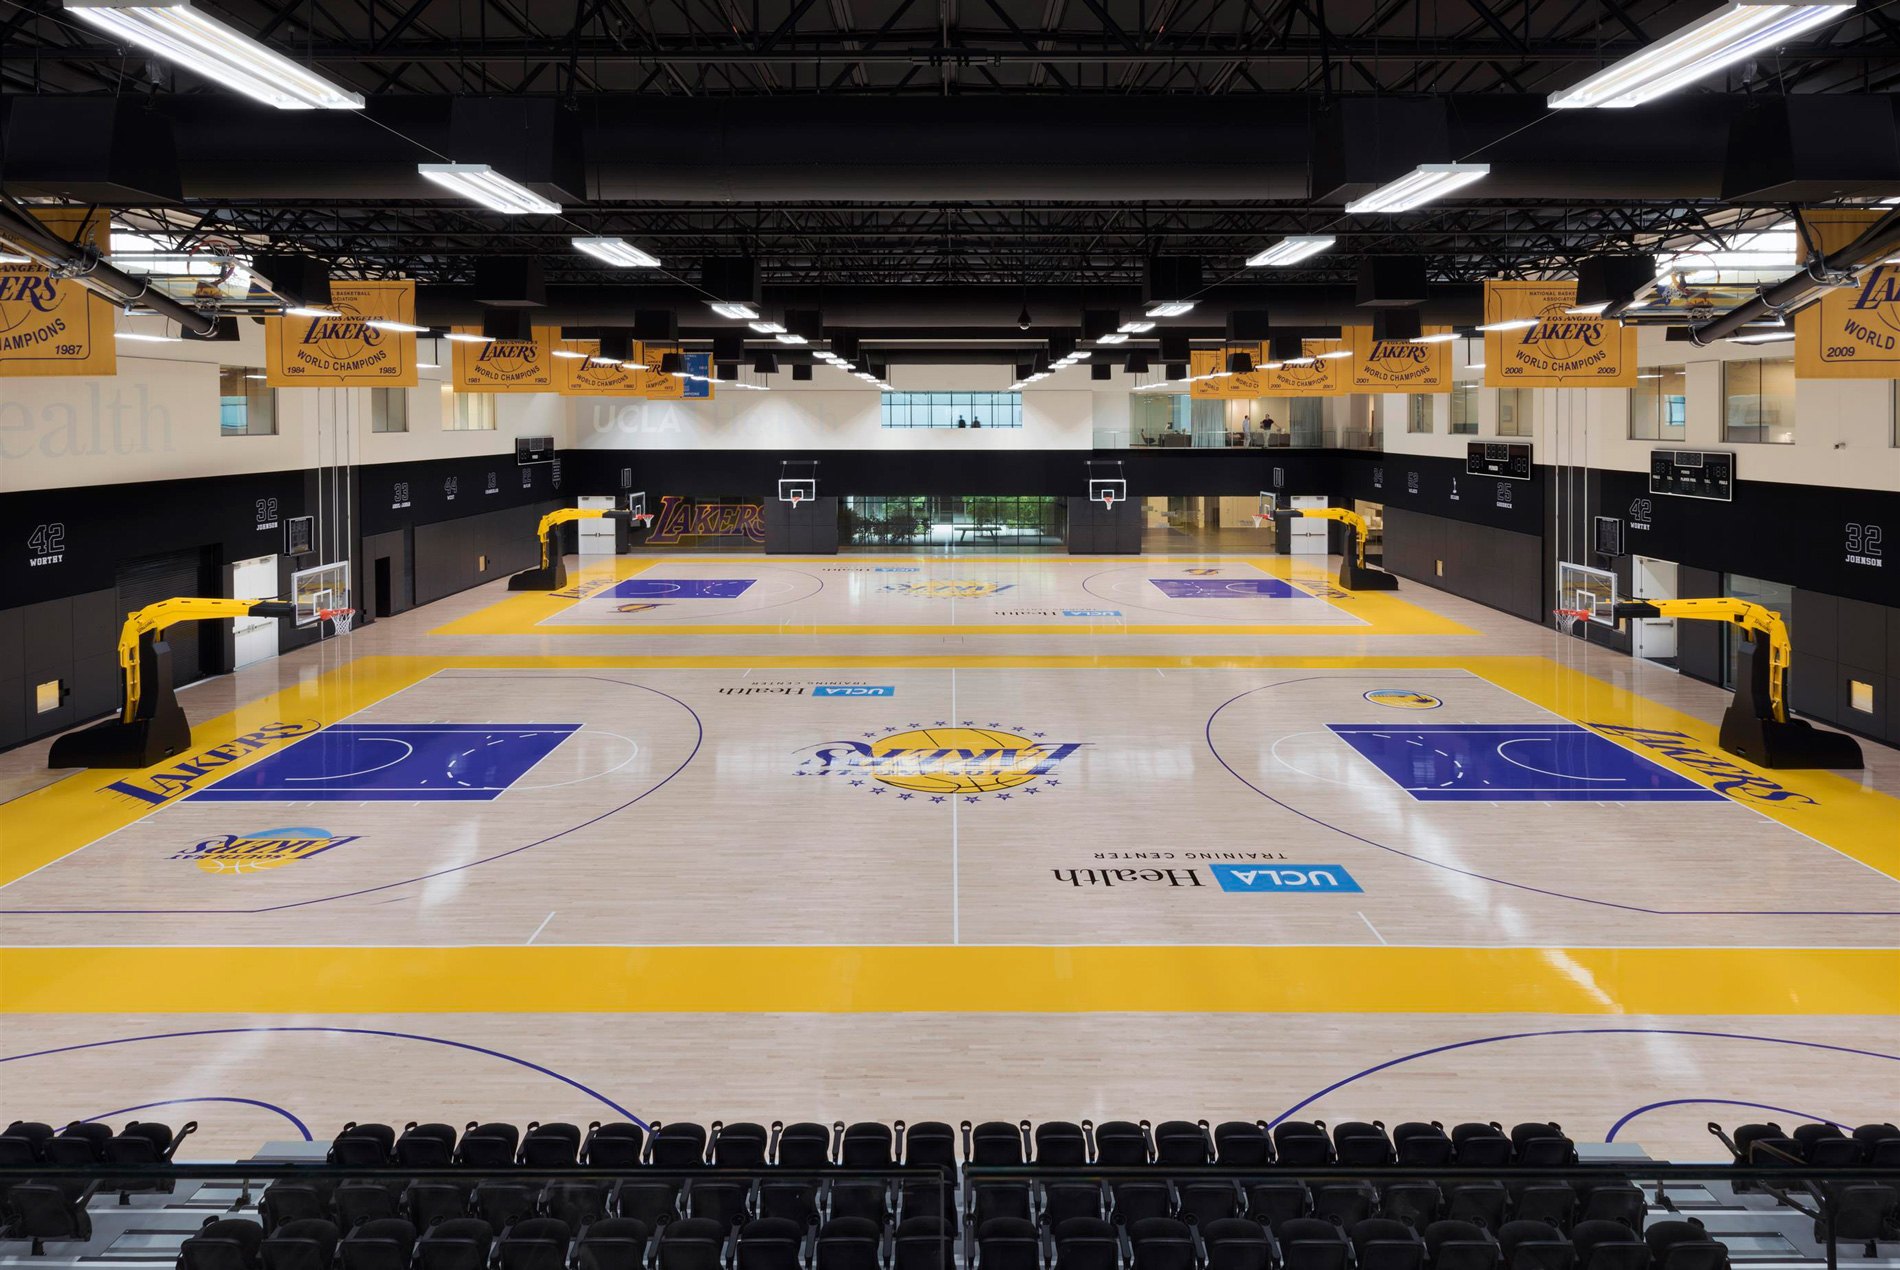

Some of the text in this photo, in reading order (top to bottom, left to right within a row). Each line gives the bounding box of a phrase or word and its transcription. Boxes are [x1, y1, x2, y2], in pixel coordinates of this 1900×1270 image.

[0, 318, 66, 351] AMPIONS
[301, 316, 386, 347] LAKERS
[1519, 316, 1608, 347] LAKERS
[1844, 318, 1895, 350] WORLD
[55, 345, 82, 355] 1987
[297, 349, 387, 371] WORLD CHAMPIONS
[478, 341, 538, 363] LAKERS
[1369, 341, 1430, 363] LAKERS
[1516, 350, 1607, 371] WORLD CHAMPIONS
[1827, 346, 1855, 358] 2009
[474, 364, 540, 381] WORLD CHAMPIONS
[576, 374, 628, 387] WORLD CHAMPIONS
[1277, 374, 1328, 387] WORLD CHAMPIONS
[1363, 365, 1430, 382] WORLD CHAMPIONS
[0, 381, 177, 460] ealth
[592, 404, 682, 433] UCLA
[256, 498, 278, 522] 32
[1629, 498, 1652, 523] 42
[256, 522, 278, 531] JOHNSON
[1630, 522, 1650, 531] WORTHY
[27, 522, 65, 555] 42
[1845, 522, 1882, 556] 32
[30, 555, 63, 567] WORTHY
[1845, 554, 1882, 567] JOHNSON
[718, 687, 805, 695] Health
[95, 719, 322, 811] LAKERS
[792, 741, 1096, 776] LAKERS
[1577, 719, 1822, 811] LAKERS
[178, 834, 370, 860] LAKERS
[1094, 852, 1287, 860] TRAINING CENTER
[1050, 868, 1338, 887] UCLA Health
